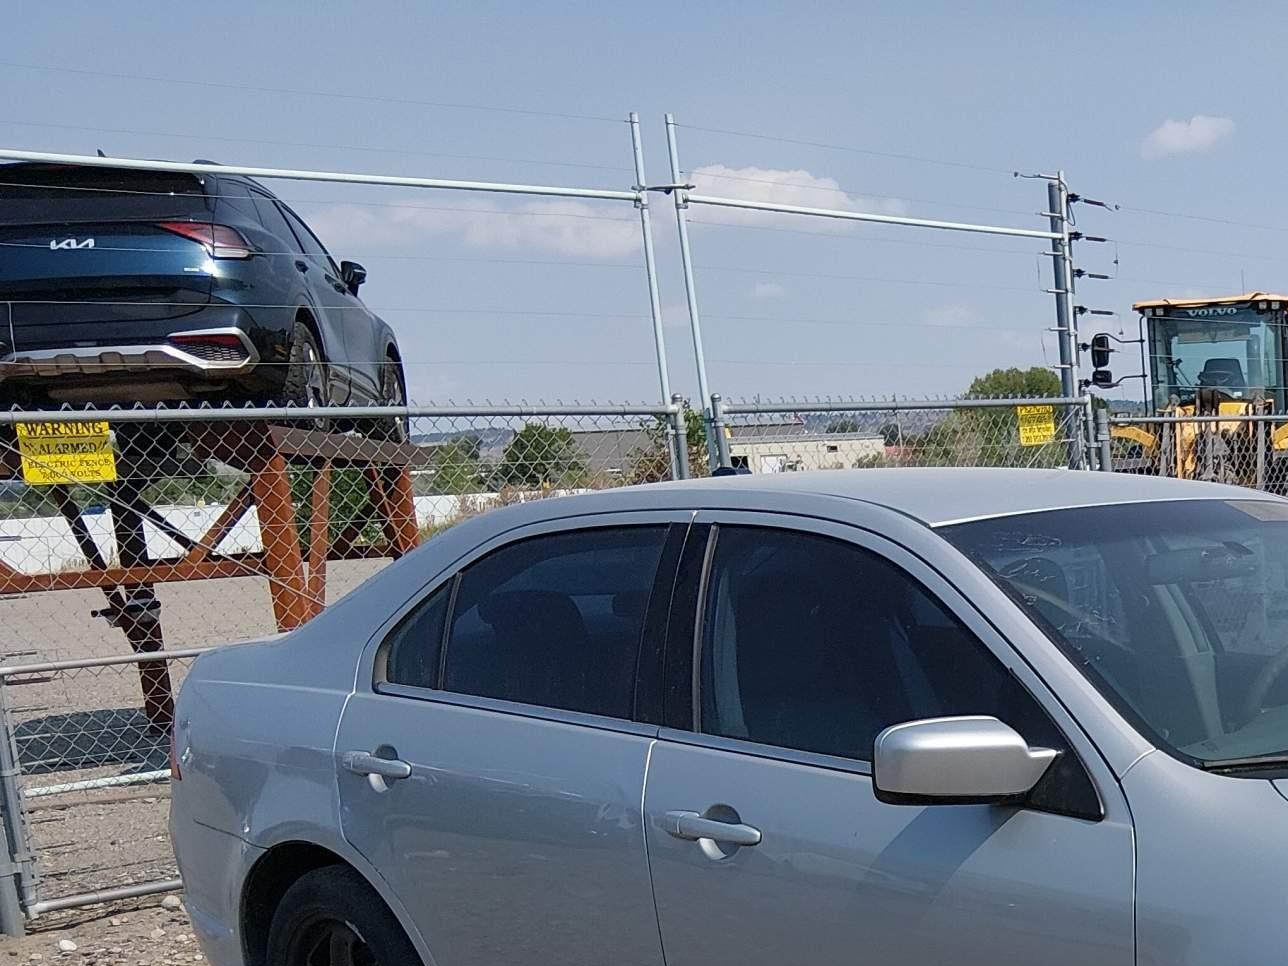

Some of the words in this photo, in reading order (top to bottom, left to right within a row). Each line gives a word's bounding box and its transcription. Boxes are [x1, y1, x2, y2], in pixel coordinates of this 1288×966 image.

[50, 238, 95, 250] KIA
[1187, 307, 1237, 317] VOLVO
[24, 422, 104, 436] WARNING
[39, 442, 97, 455] ALARMED
[28, 459, 78, 469] ELECTRIC
[80, 458, 111, 468] FENCE
[70, 469, 102, 478] VOLTS
